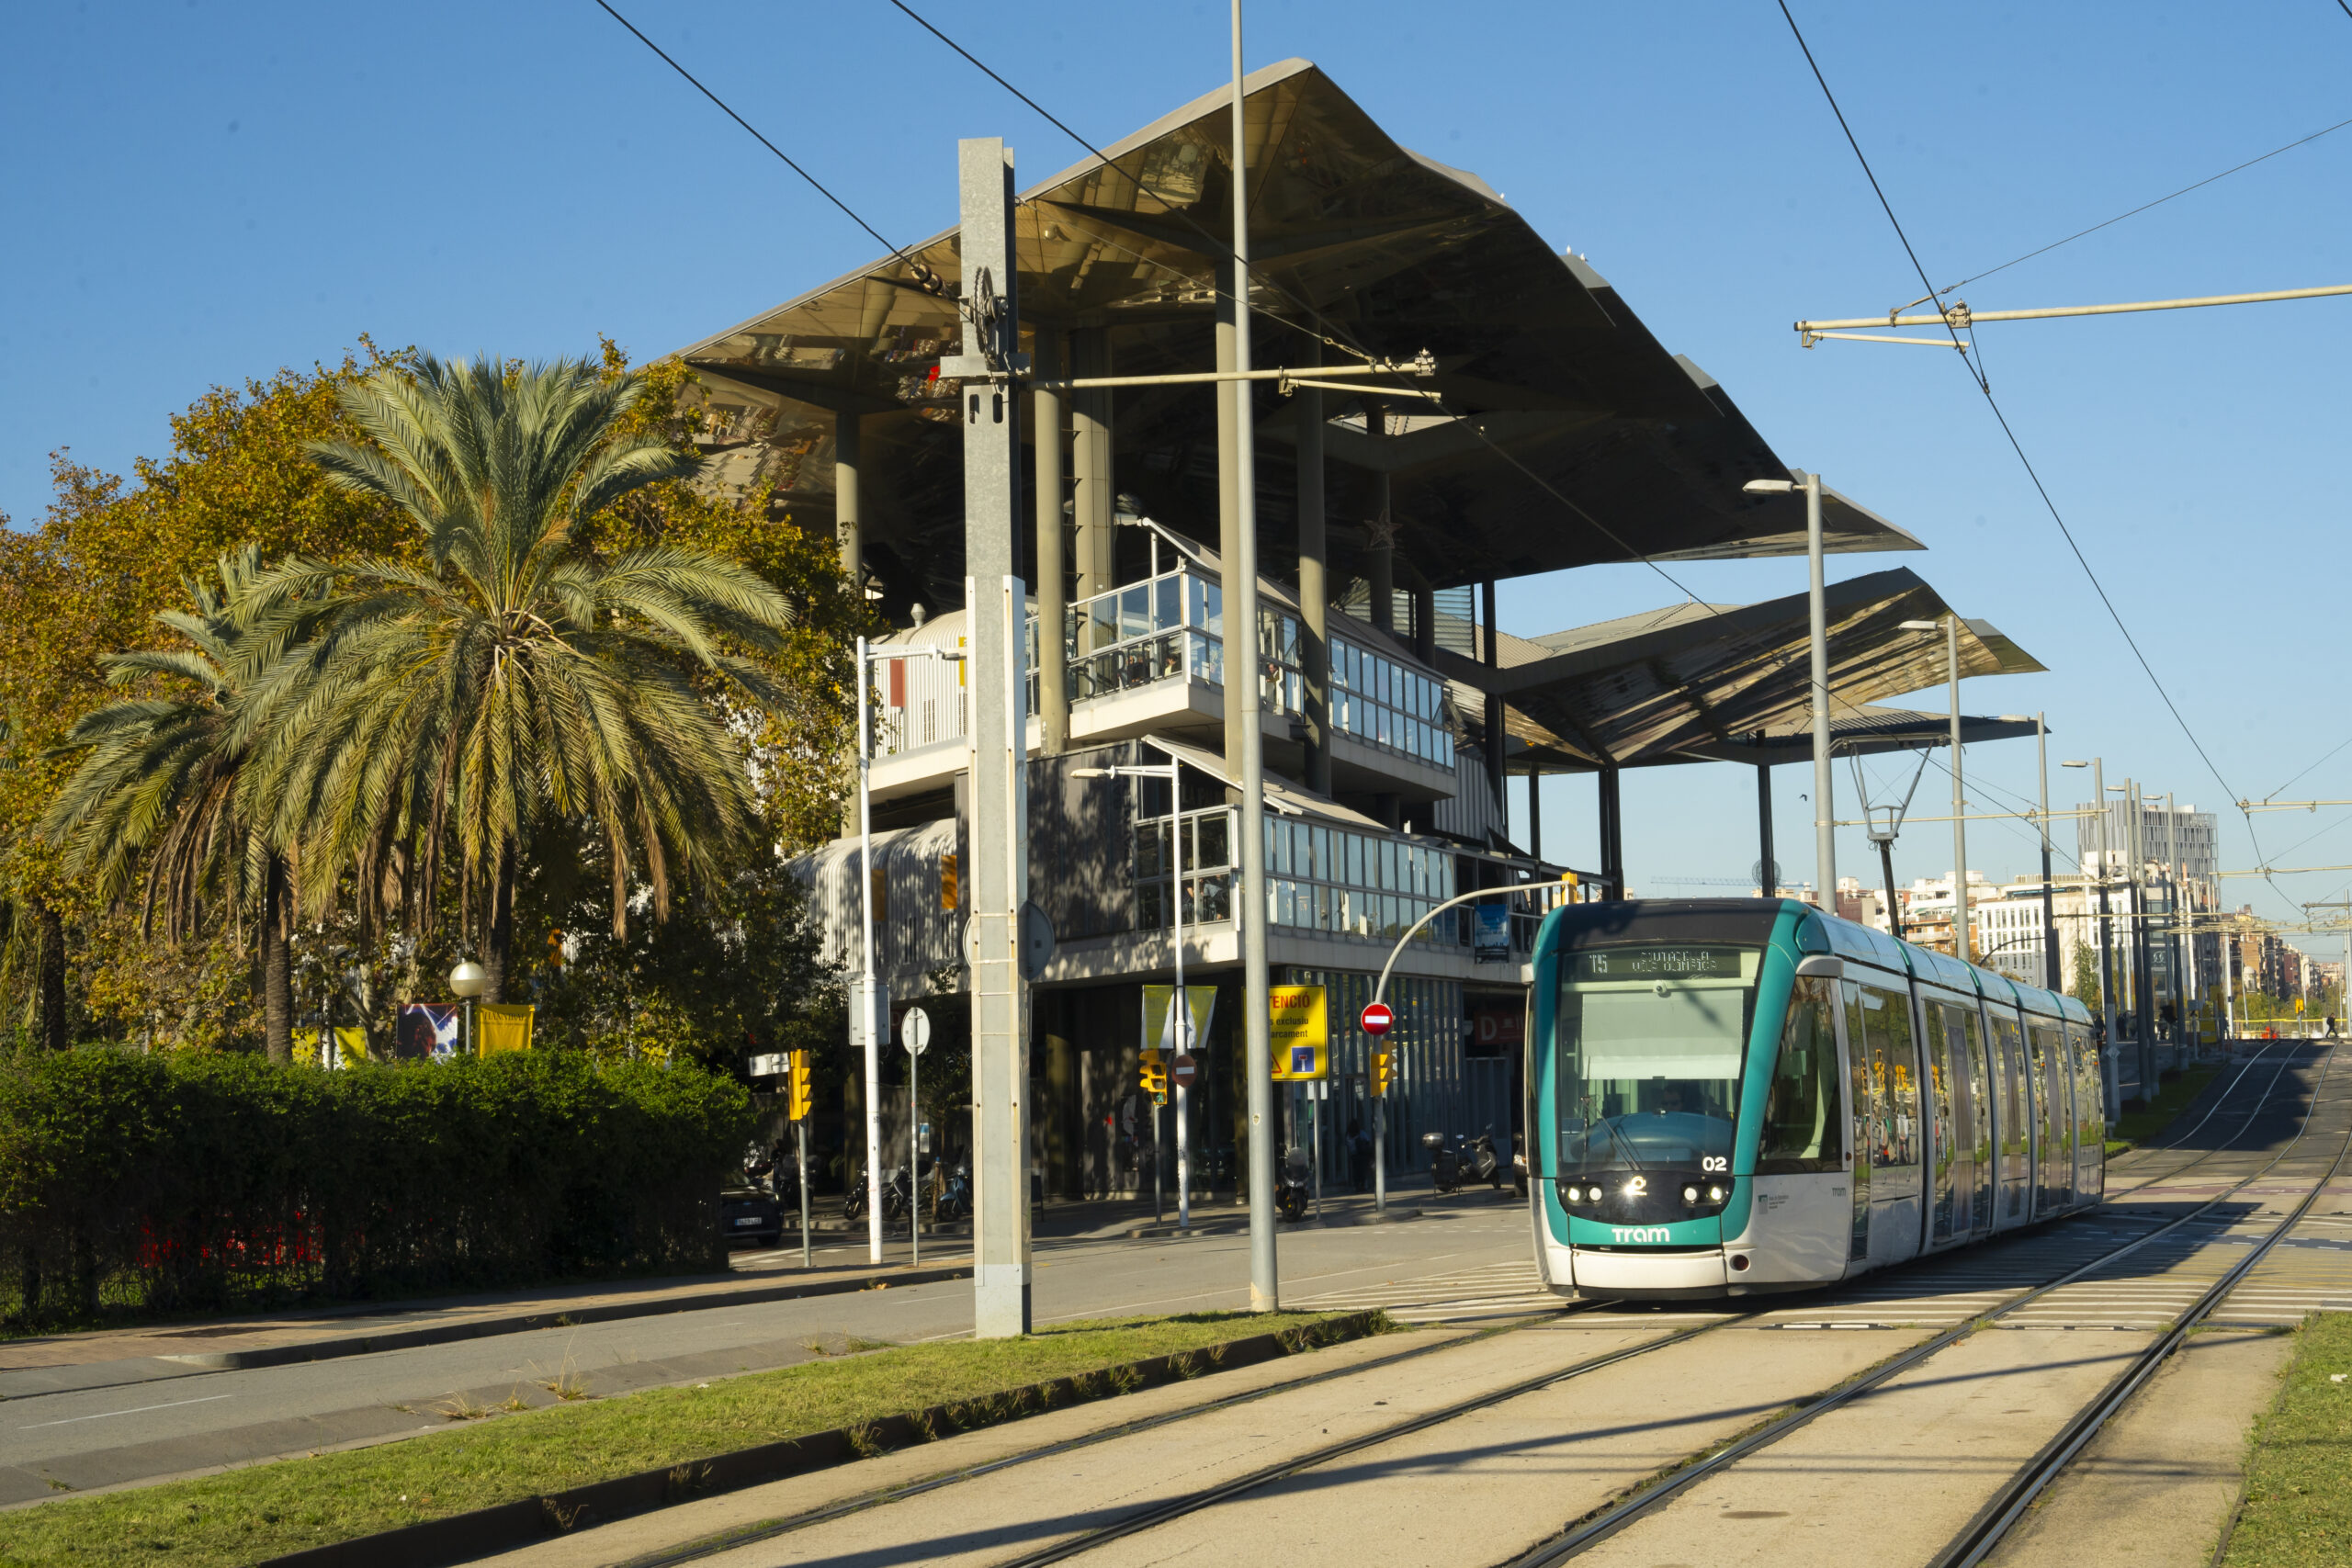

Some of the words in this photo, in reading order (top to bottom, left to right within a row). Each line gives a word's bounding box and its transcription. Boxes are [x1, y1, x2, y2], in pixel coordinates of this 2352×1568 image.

[1270, 992, 1310, 1009] ENCIÓ
[1275, 1017, 1309, 1026] exclusiu
[1702, 1156, 1727, 1171] 02
